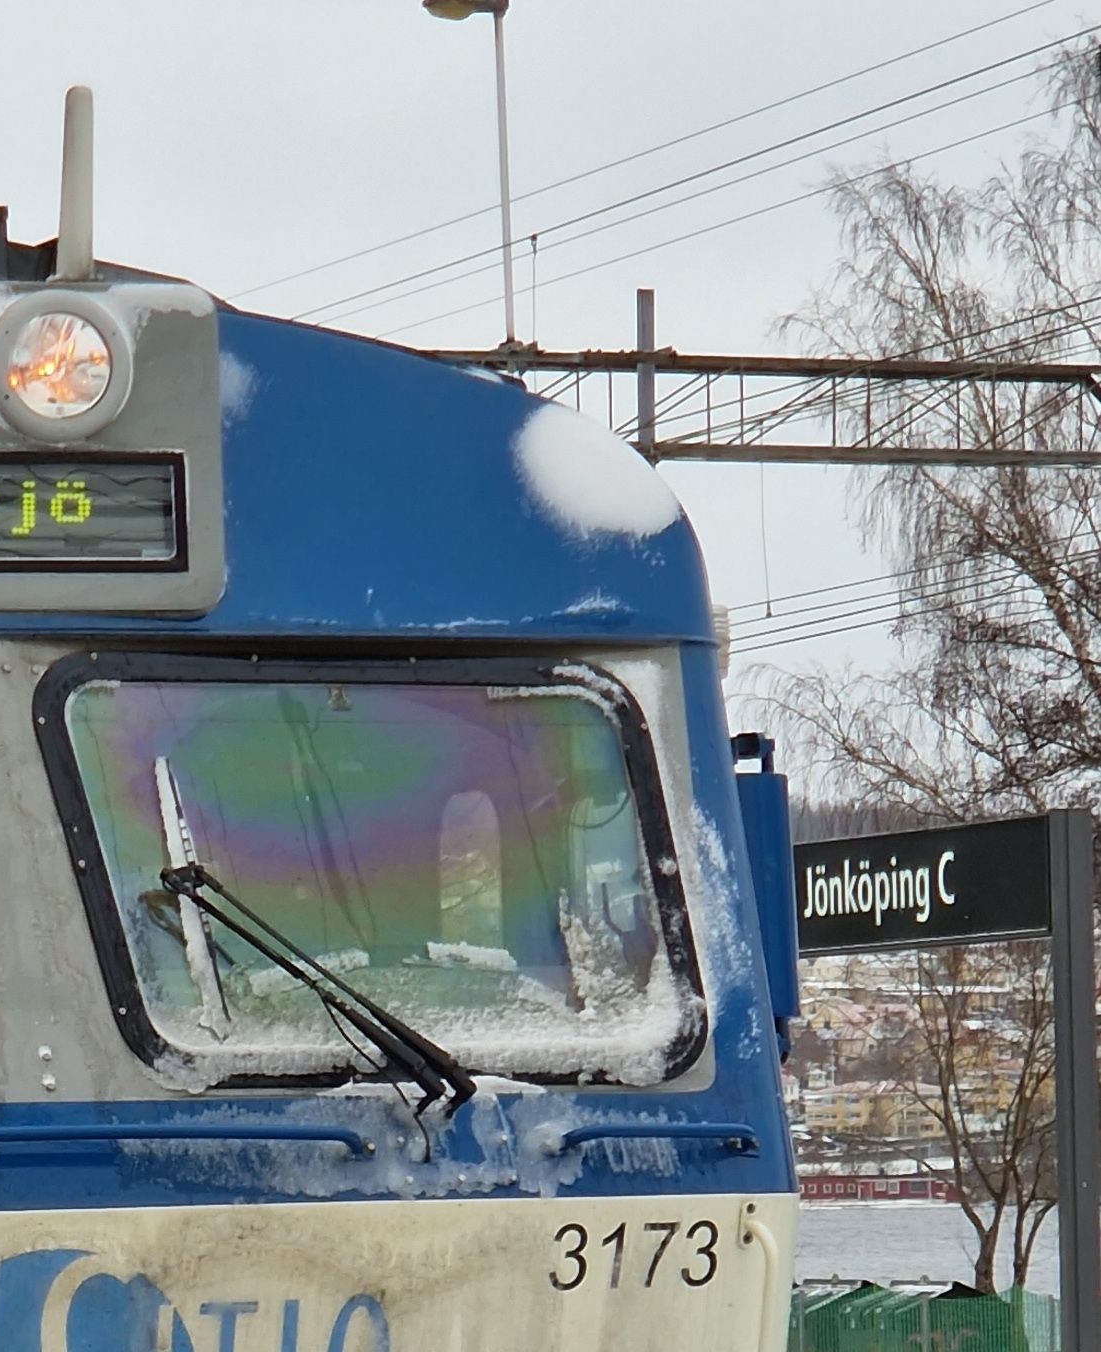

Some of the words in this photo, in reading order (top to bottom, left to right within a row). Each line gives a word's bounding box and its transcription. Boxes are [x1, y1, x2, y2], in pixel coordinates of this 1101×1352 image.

[803, 856, 931, 927] Jönköping
[937, 850, 956, 905] C
[548, 1219, 719, 1292] 3173
